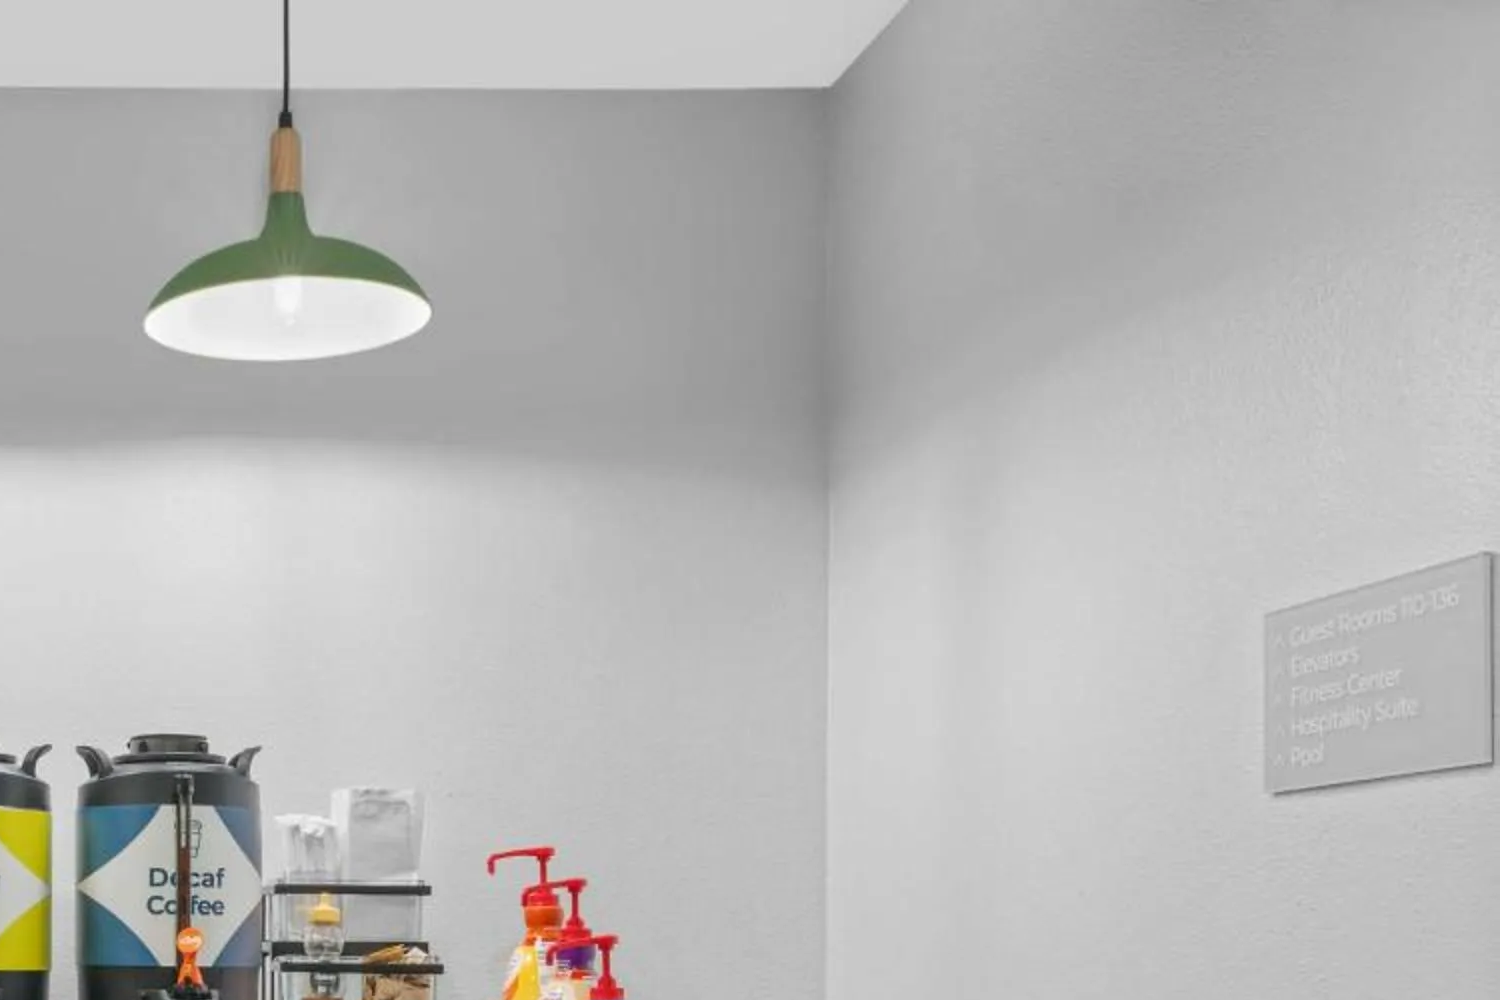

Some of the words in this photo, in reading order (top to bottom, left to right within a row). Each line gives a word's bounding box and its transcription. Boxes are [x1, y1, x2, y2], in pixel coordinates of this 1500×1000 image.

[1289, 619, 1335, 648] Guest
[1338, 604, 1398, 634] Rooms
[1291, 645, 1360, 678] Elevators
[1290, 681, 1344, 706] Fitness
[1347, 668, 1403, 694] Center
[1291, 702, 1371, 738] Hospitality
[1375, 697, 1420, 722] Suite
[1291, 741, 1325, 768] Pool
[146, 895, 225, 915] Cofee
